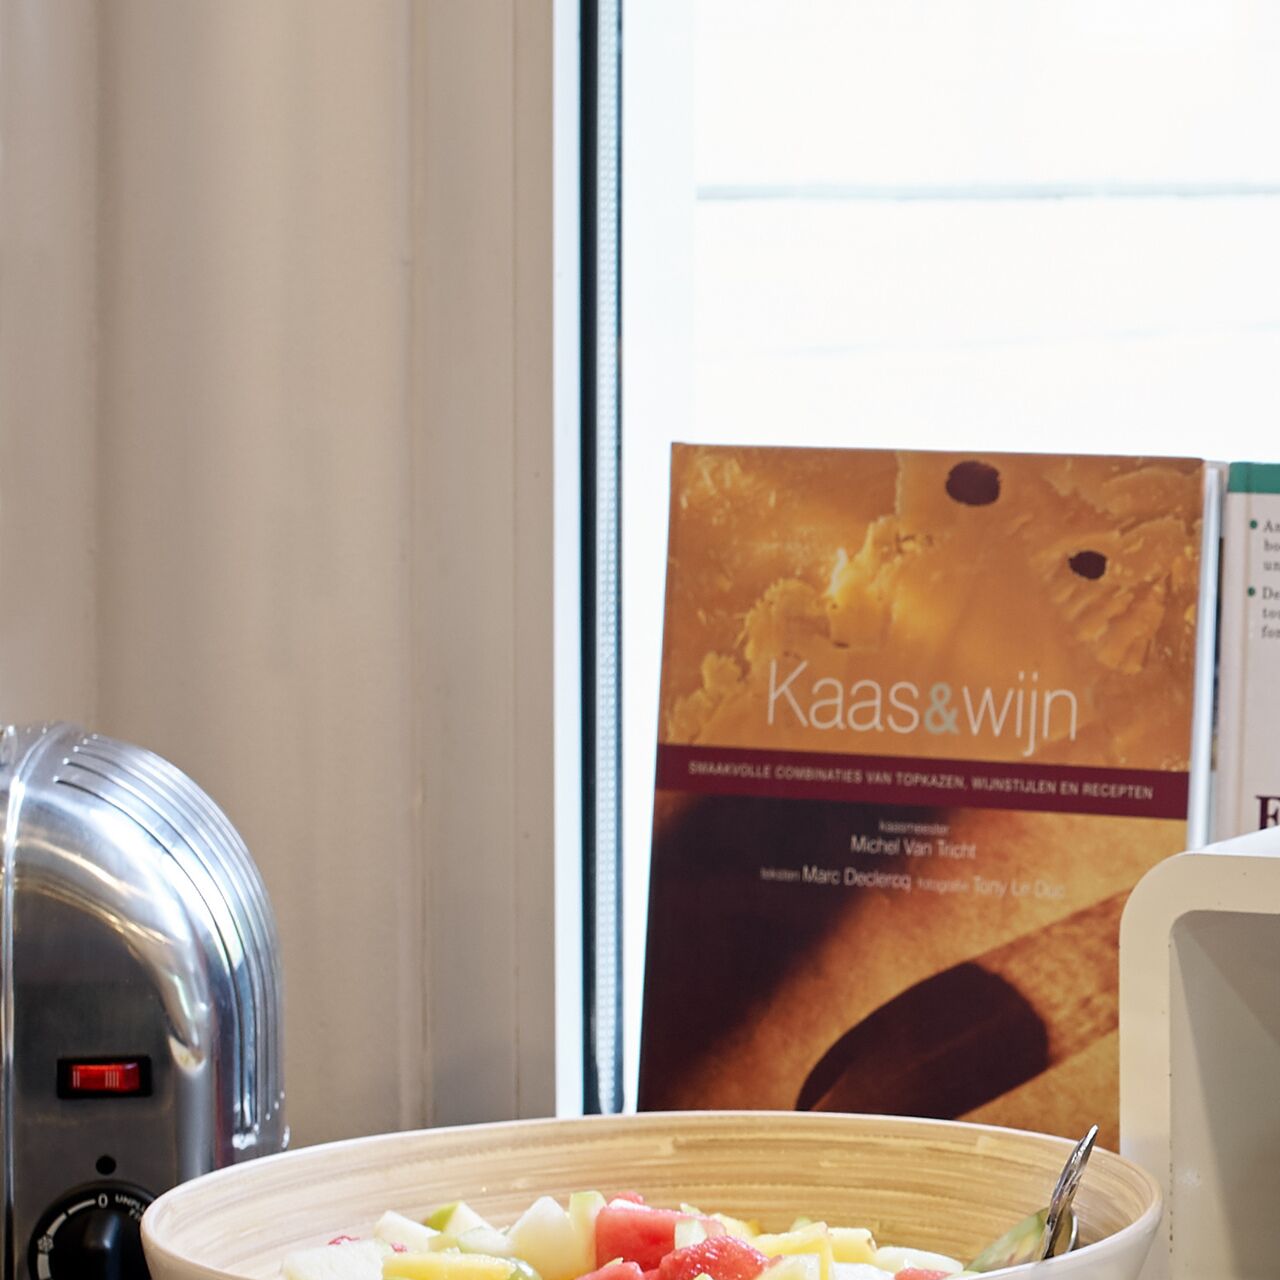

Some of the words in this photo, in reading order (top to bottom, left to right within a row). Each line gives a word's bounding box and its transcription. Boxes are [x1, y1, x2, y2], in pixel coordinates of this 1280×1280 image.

[768, 657, 1078, 757] Kaas&wijn
[688, 760, 770, 779] SMAAKVOLLE
[774, 765, 862, 784] COMBINATIES
[865, 771, 892, 785] VAN
[1060, 783, 1079, 796] EN
[1082, 784, 1154, 801] RECEPTEN
[851, 835, 900, 855] Michel
[903, 838, 932, 856] Van
[936, 839, 977, 860] Tricht
[802, 864, 840, 885] Marc
[843, 867, 912, 891] Declercq
[973, 875, 1008, 898] Tony
